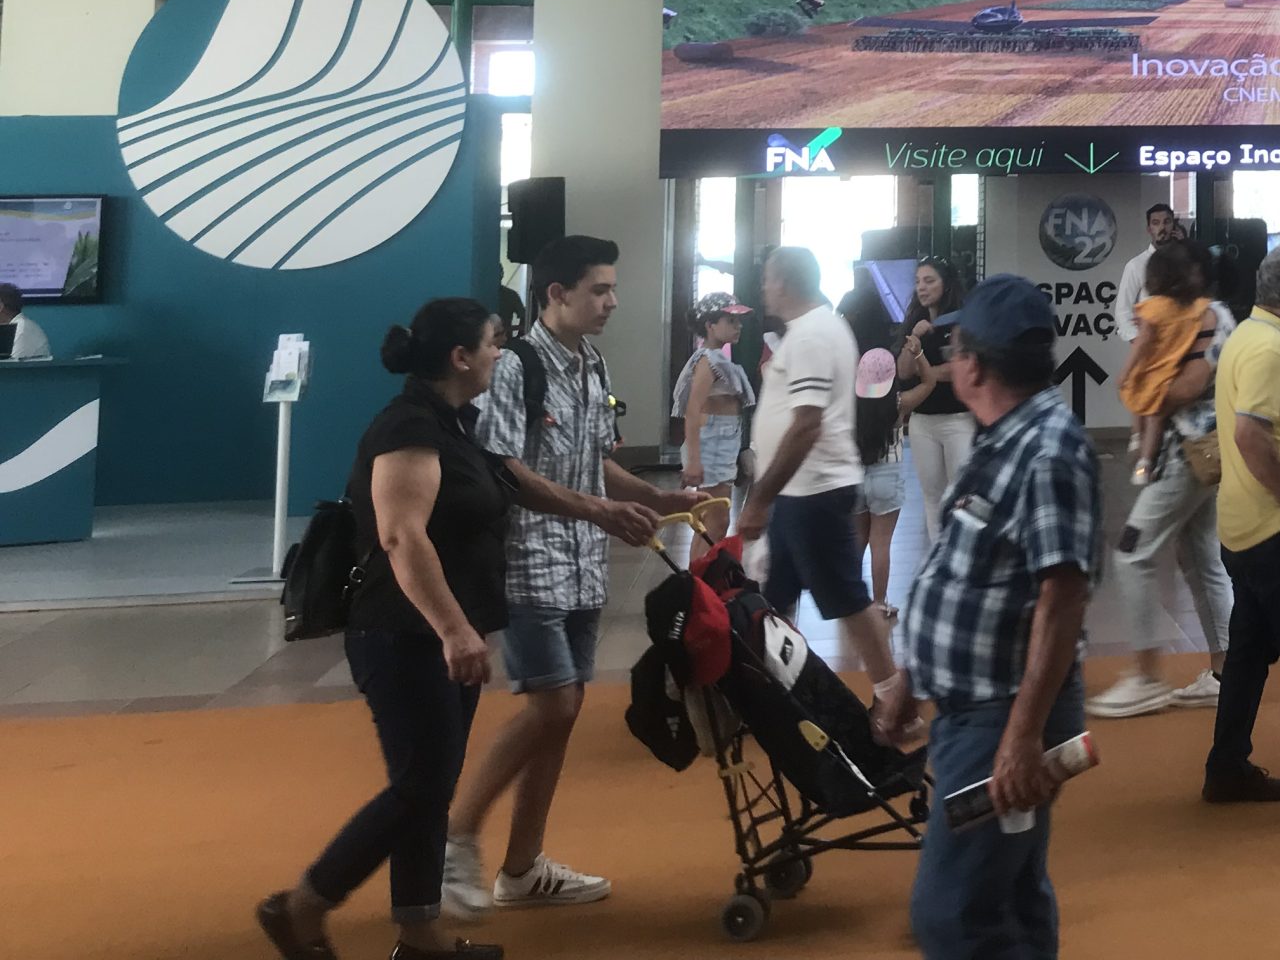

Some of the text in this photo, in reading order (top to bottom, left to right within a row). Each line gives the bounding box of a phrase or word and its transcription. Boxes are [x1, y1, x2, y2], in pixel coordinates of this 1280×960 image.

[765, 146, 836, 172] FNA
[885, 140, 1046, 174] Visite aqui
[1139, 145, 1231, 171] Espaço
[1046, 207, 1114, 236] FNA
